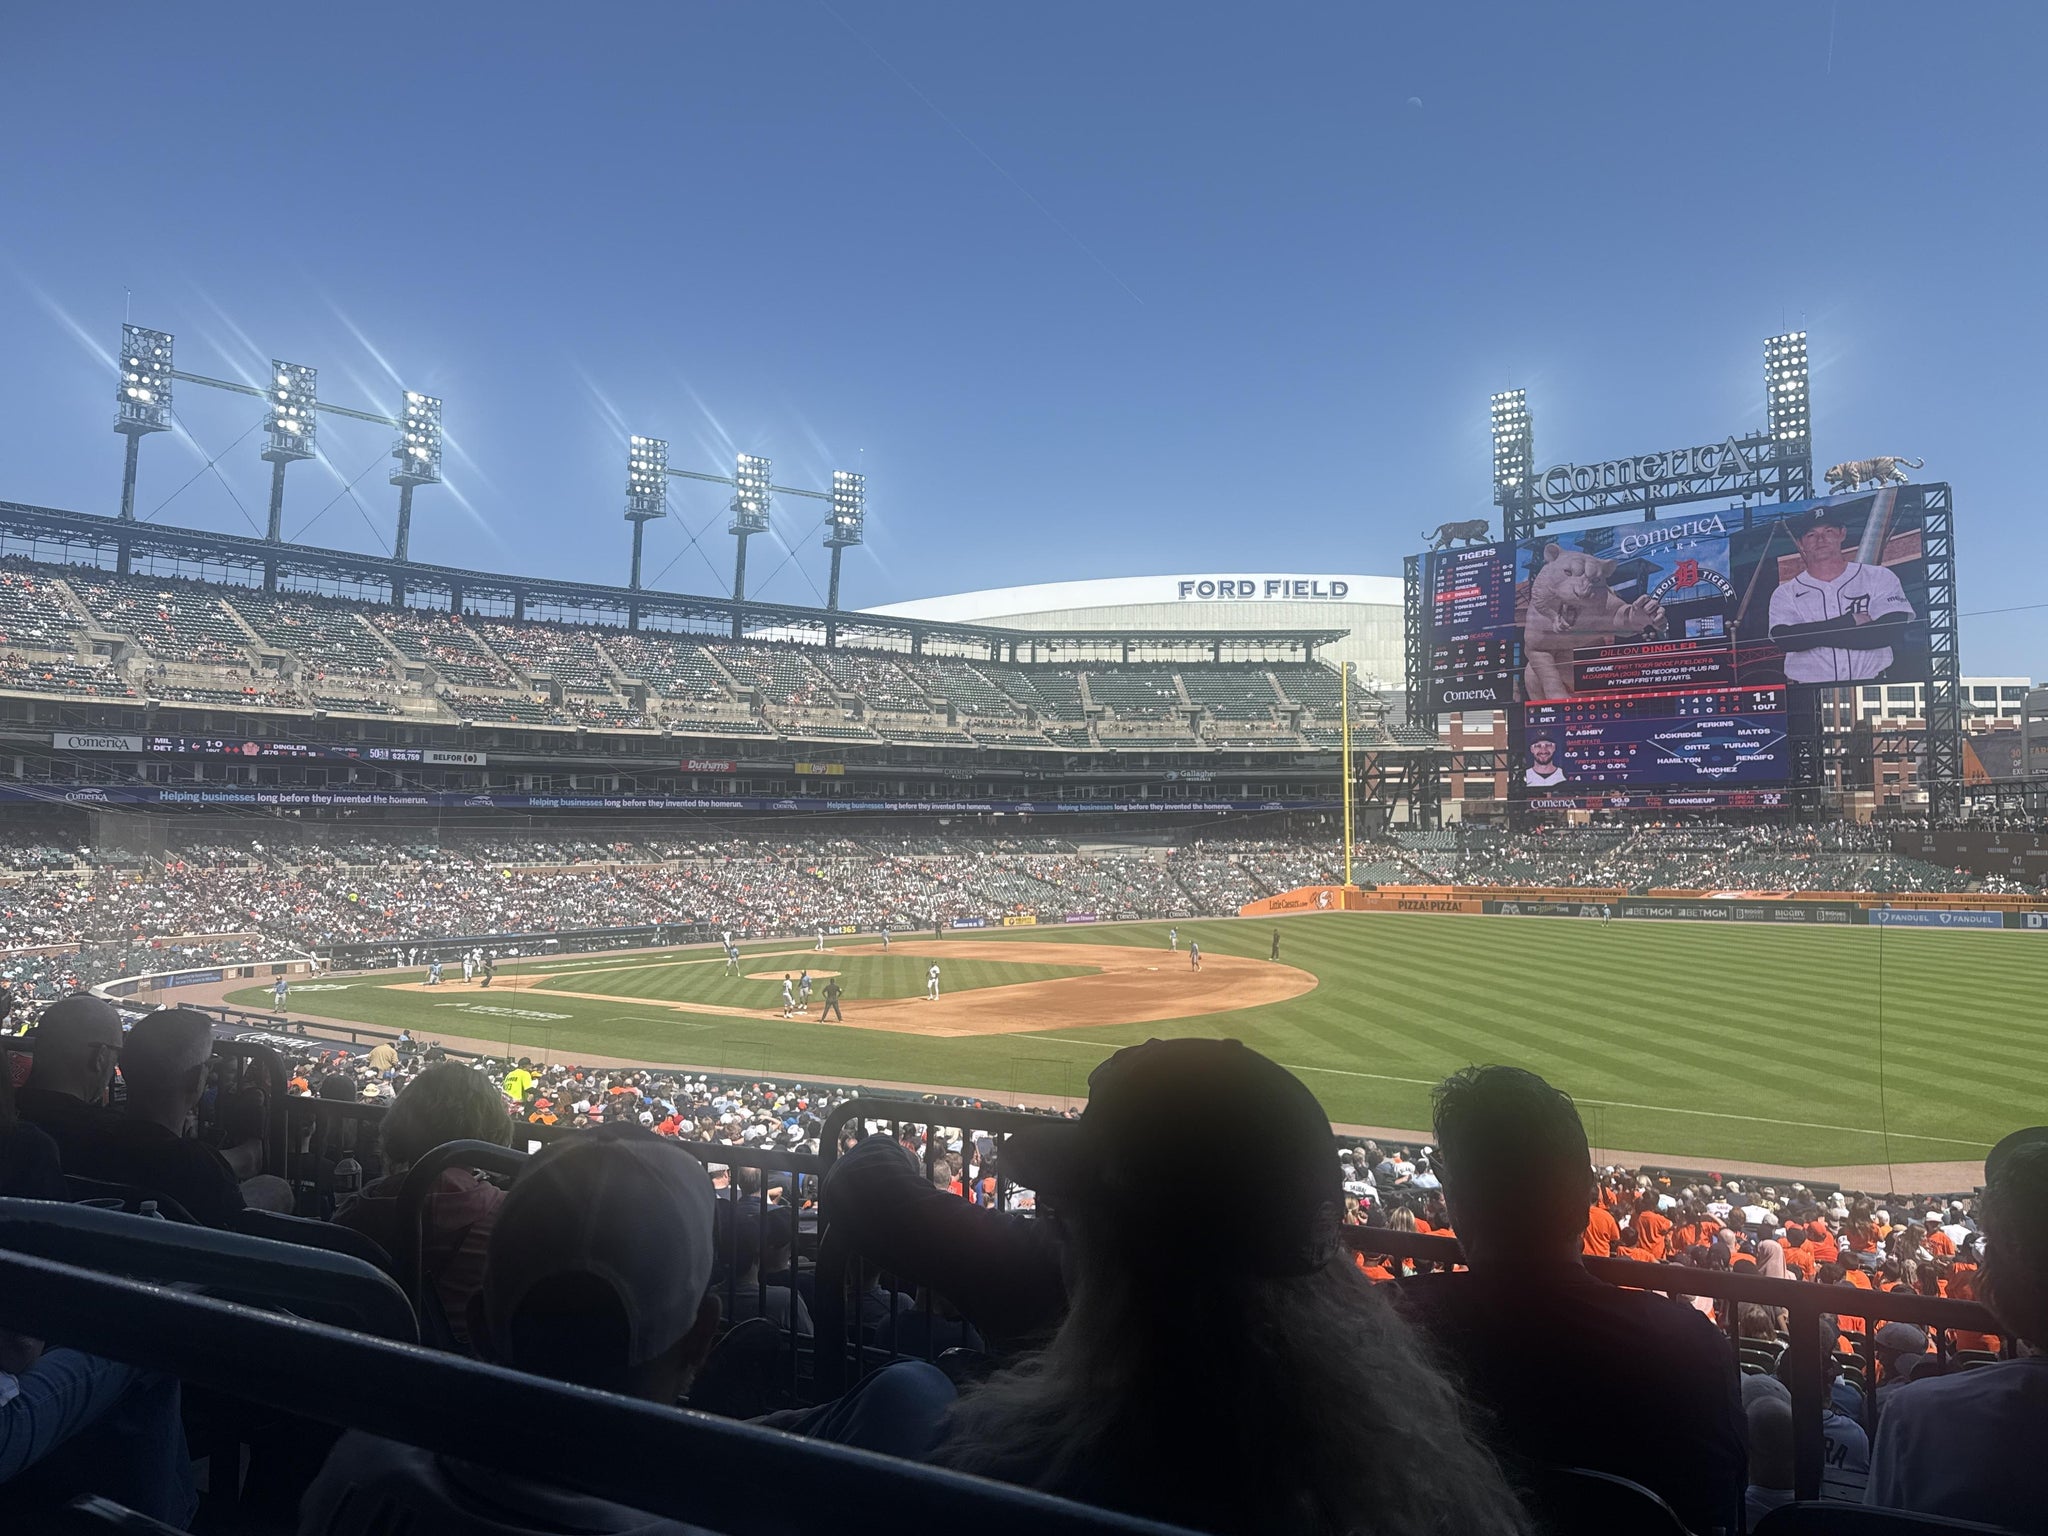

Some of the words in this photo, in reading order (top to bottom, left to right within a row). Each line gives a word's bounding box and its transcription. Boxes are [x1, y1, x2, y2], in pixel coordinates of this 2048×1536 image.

[1594, 480, 1693, 508] PARK
[1651, 540, 1697, 556] PARK
[1458, 548, 1496, 561] TIGERS
[1178, 580, 1256, 599] FORD
[1264, 579, 1349, 599] FIELD
[1703, 571, 1733, 597] TIGERS
[1600, 647, 1639, 657] DILLON
[1642, 642, 1696, 653] DINGLER
[1753, 692, 1775, 702] 1-1
[1654, 732, 1702, 740] LOCKRIDGE
[433, 754, 462, 762] BELFOR
[688, 760, 729, 769] Dunham's
[1180, 770, 1216, 778] Gallagher
[160, 790, 200, 802] Helping
[202, 791, 256, 802] businesses
[258, 793, 278, 802] long
[280, 793, 310, 802] before
[312, 794, 332, 804] they
[334, 794, 371, 804] invented
[373, 796, 388, 804] the
[389, 796, 428, 804] homerun.
[529, 798, 558, 807] Helping
[560, 798, 602, 807] businesses
[604, 799, 621, 808] long
[622, 799, 649, 808] before
[648, 800, 664, 808] they
[666, 800, 696, 808] invented
[698, 800, 710, 808] the
[710, 800, 743, 808] homerun.
[827, 802, 850, 810] Helping
[885, 802, 898, 810] long
[918, 802, 931, 810] they
[1924, 836, 1932, 844] 23
[2034, 838, 2039, 847] 2
[2012, 856, 2022, 866] 47
[1398, 900, 1429, 910] PIZZA!
[1430, 902, 1462, 912] PIZZA!
[1634, 907, 1672, 916] BETMGM
[1686, 908, 1727, 918] BETMGM
[828, 926, 856, 934] bet365
